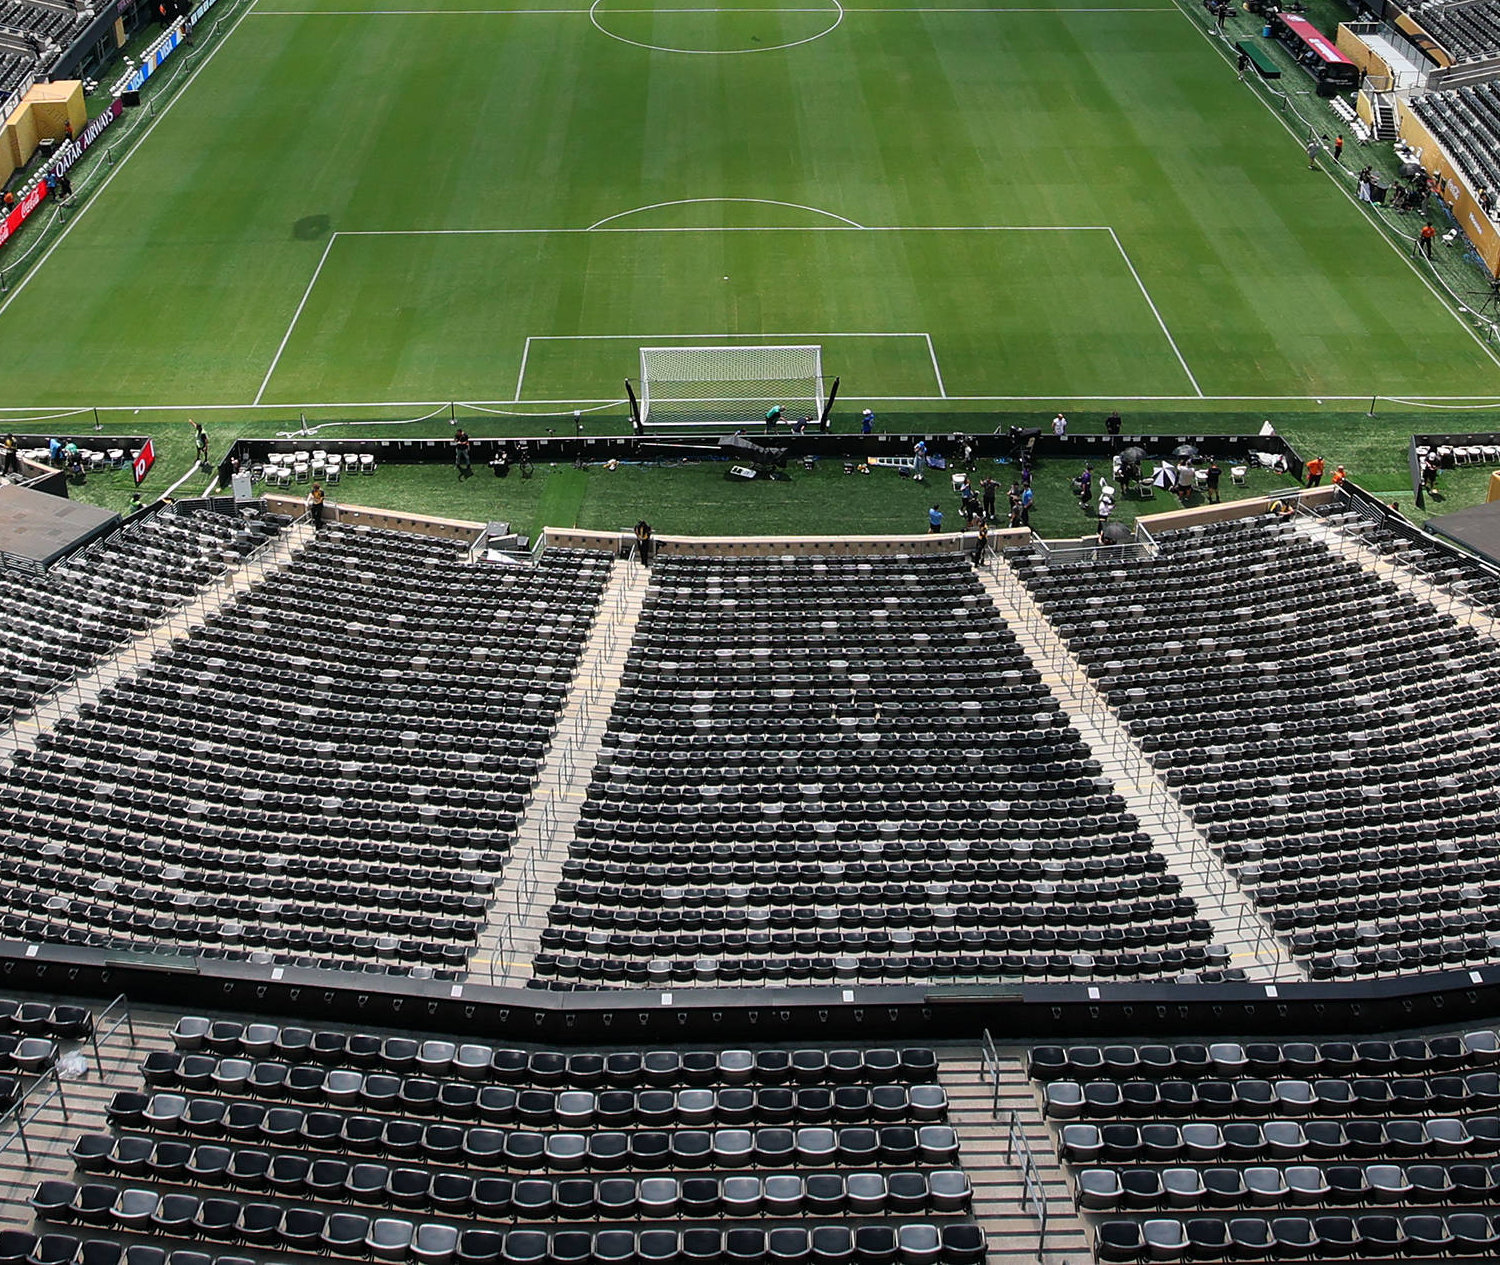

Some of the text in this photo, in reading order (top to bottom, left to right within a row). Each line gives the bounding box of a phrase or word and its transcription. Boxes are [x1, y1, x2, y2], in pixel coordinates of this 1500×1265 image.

[130, 69, 145, 91] VISA
[56, 107, 114, 178] QATAR AIRWAYS
